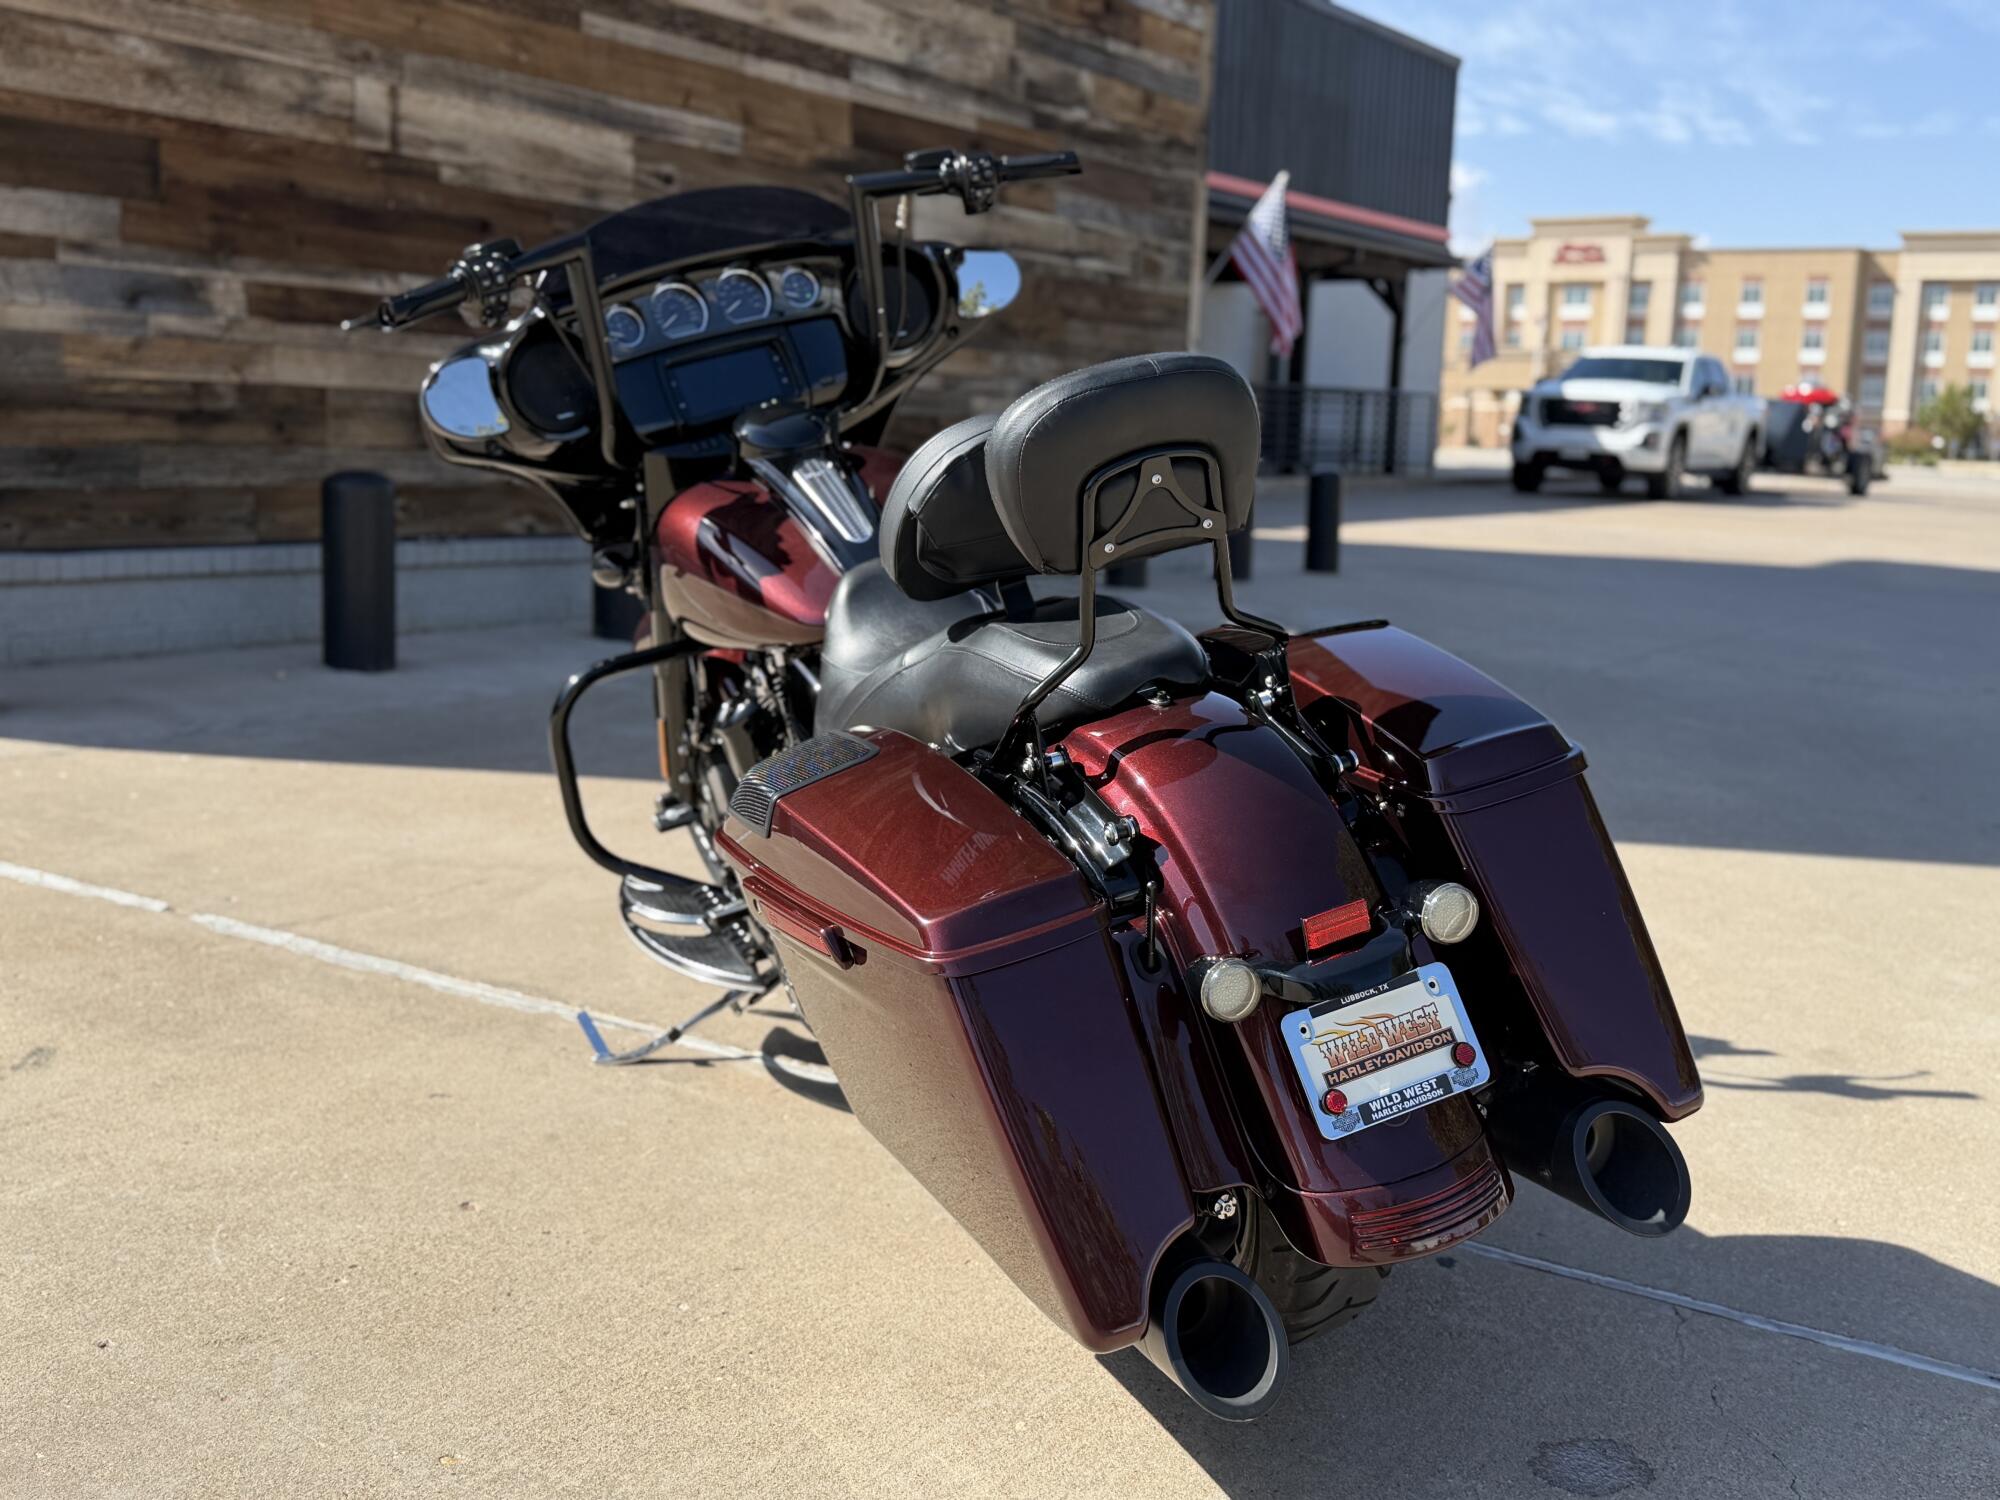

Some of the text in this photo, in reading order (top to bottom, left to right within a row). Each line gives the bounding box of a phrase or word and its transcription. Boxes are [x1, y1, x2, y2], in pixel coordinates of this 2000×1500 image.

[1340, 983, 1389, 1005] LUBBOCK, TX
[1318, 1002, 1442, 1068] WILD WEST
[1327, 1031, 1453, 1085] HARLEY-DAVIDSON
[1369, 1079, 1437, 1112] WILD WEST
[1371, 1088, 1444, 1121] HARLEY-DAVIDSON
